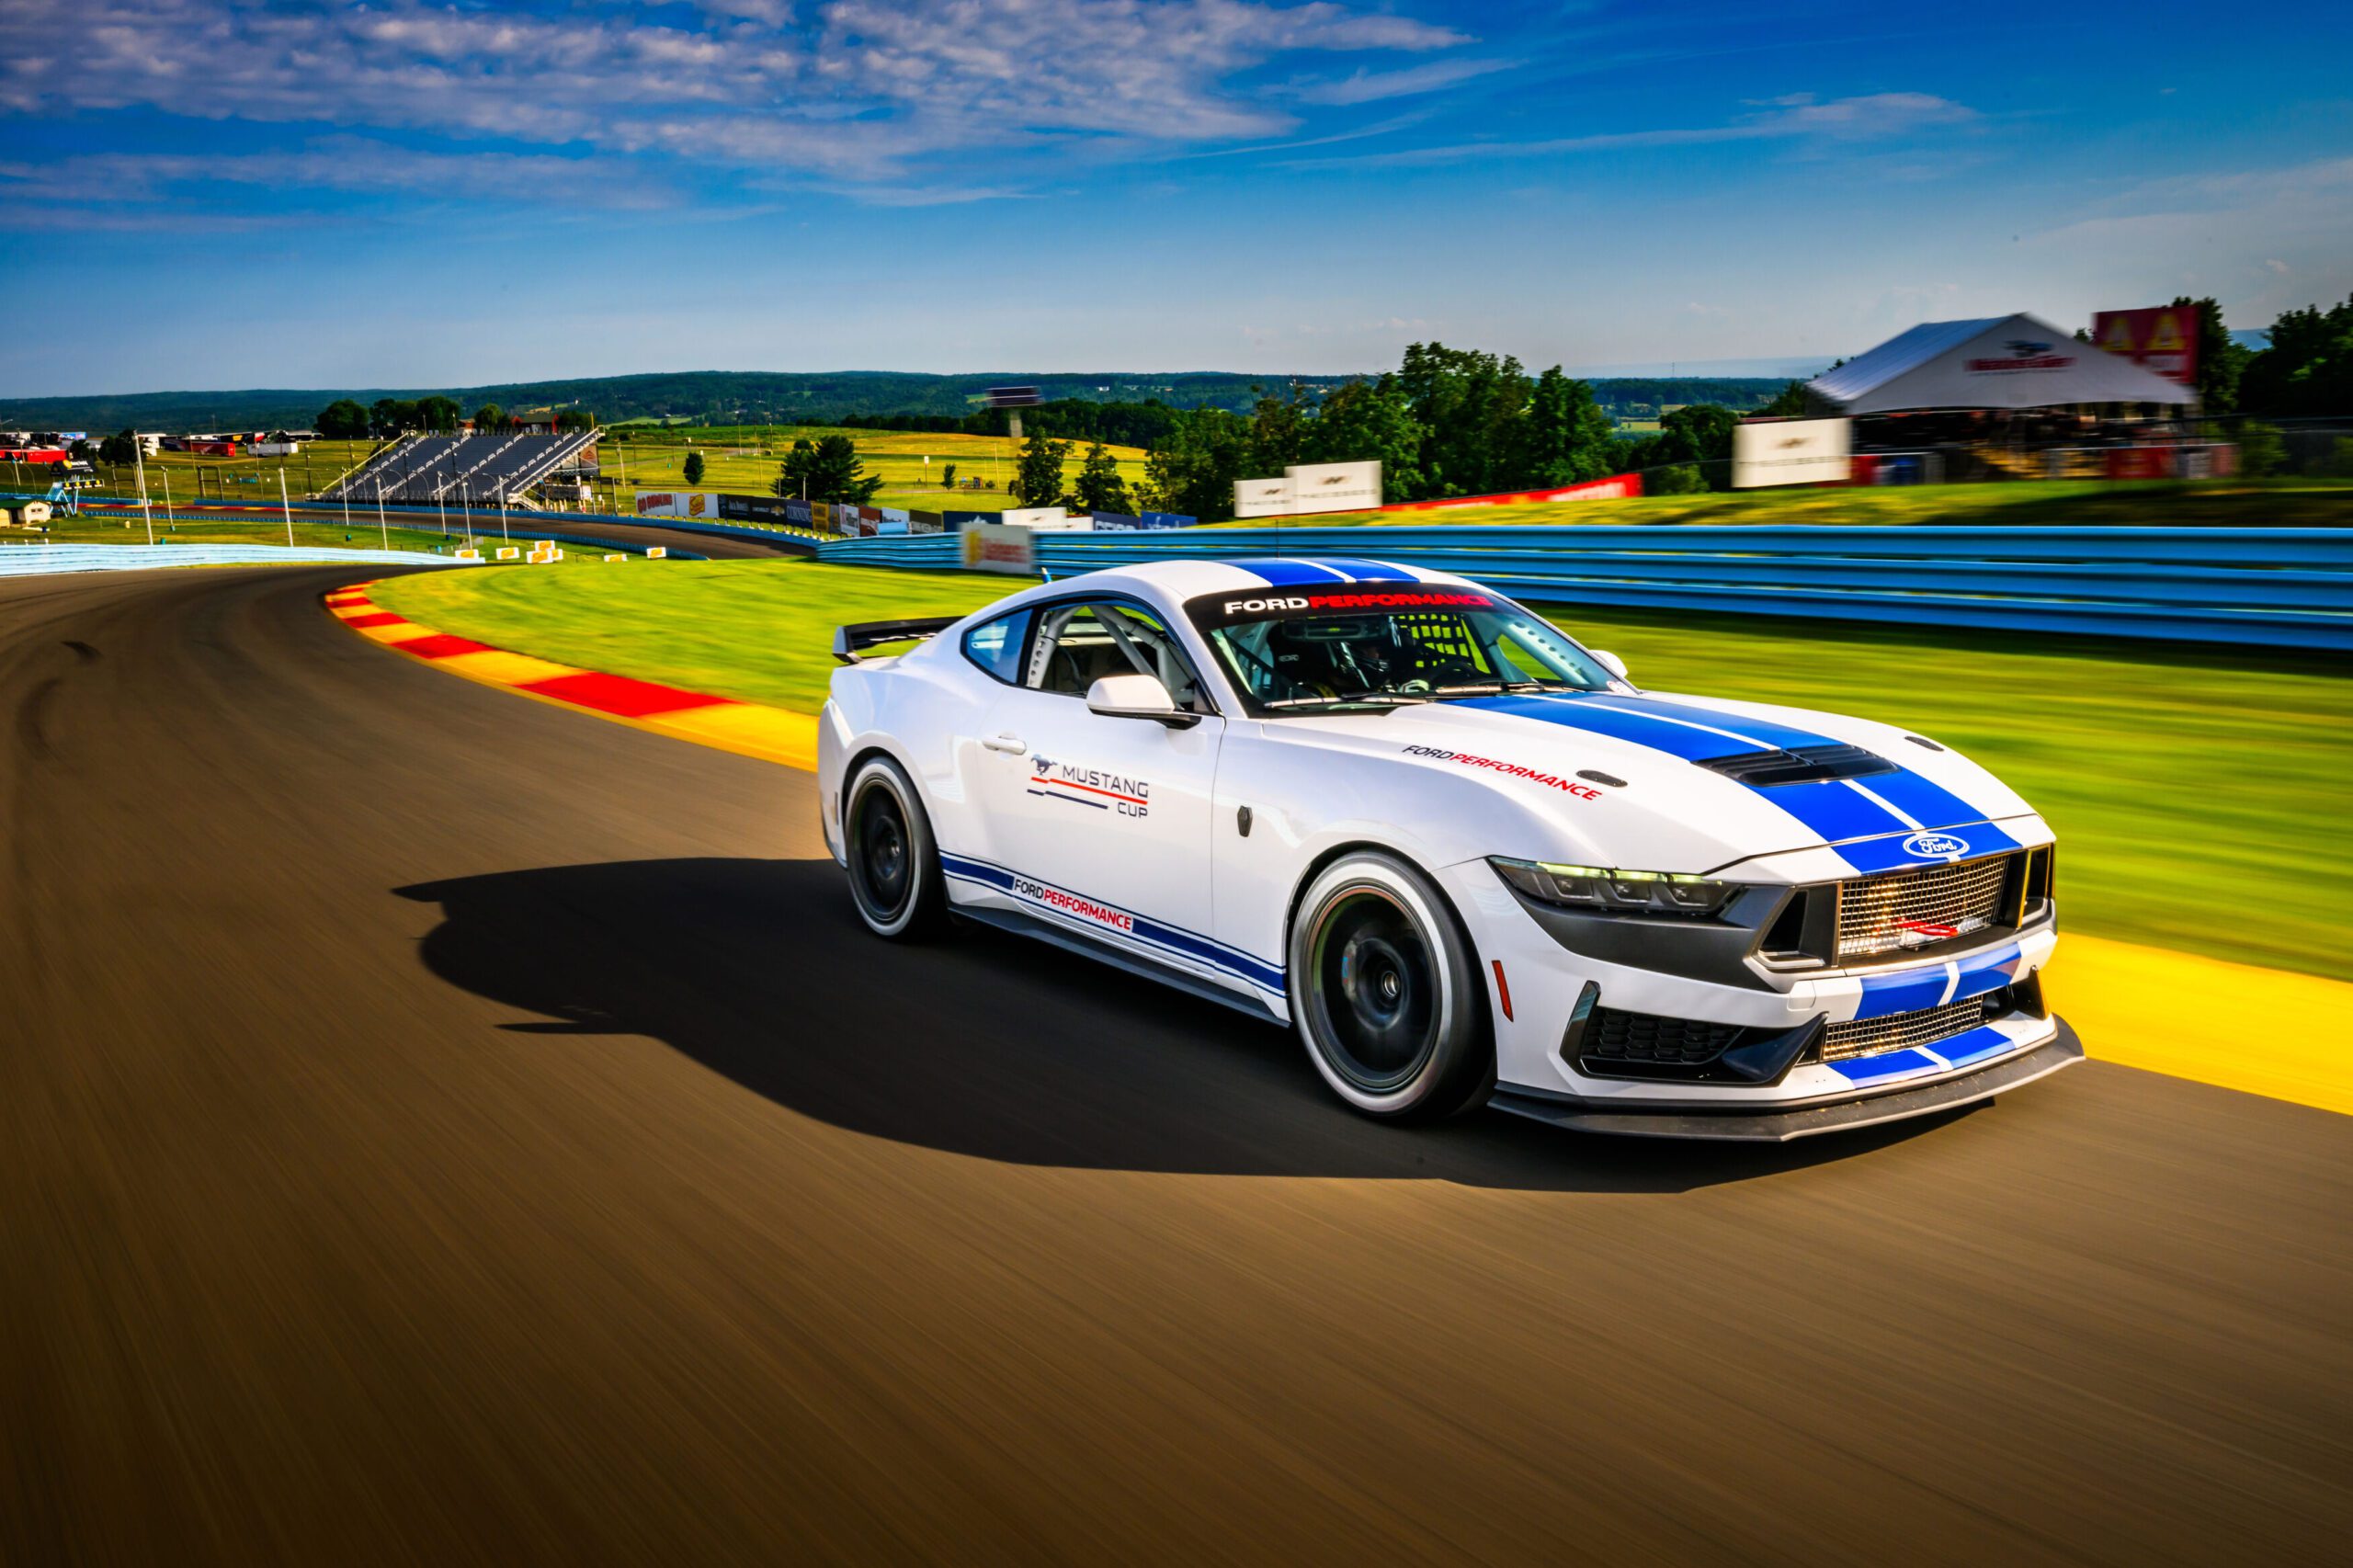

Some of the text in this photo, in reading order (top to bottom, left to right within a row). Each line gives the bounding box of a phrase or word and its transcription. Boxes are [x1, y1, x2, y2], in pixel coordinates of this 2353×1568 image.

[1063, 765, 1148, 798] MUSTANG
[1118, 802, 1148, 818] CUP
[1918, 837, 1958, 854] Ford
